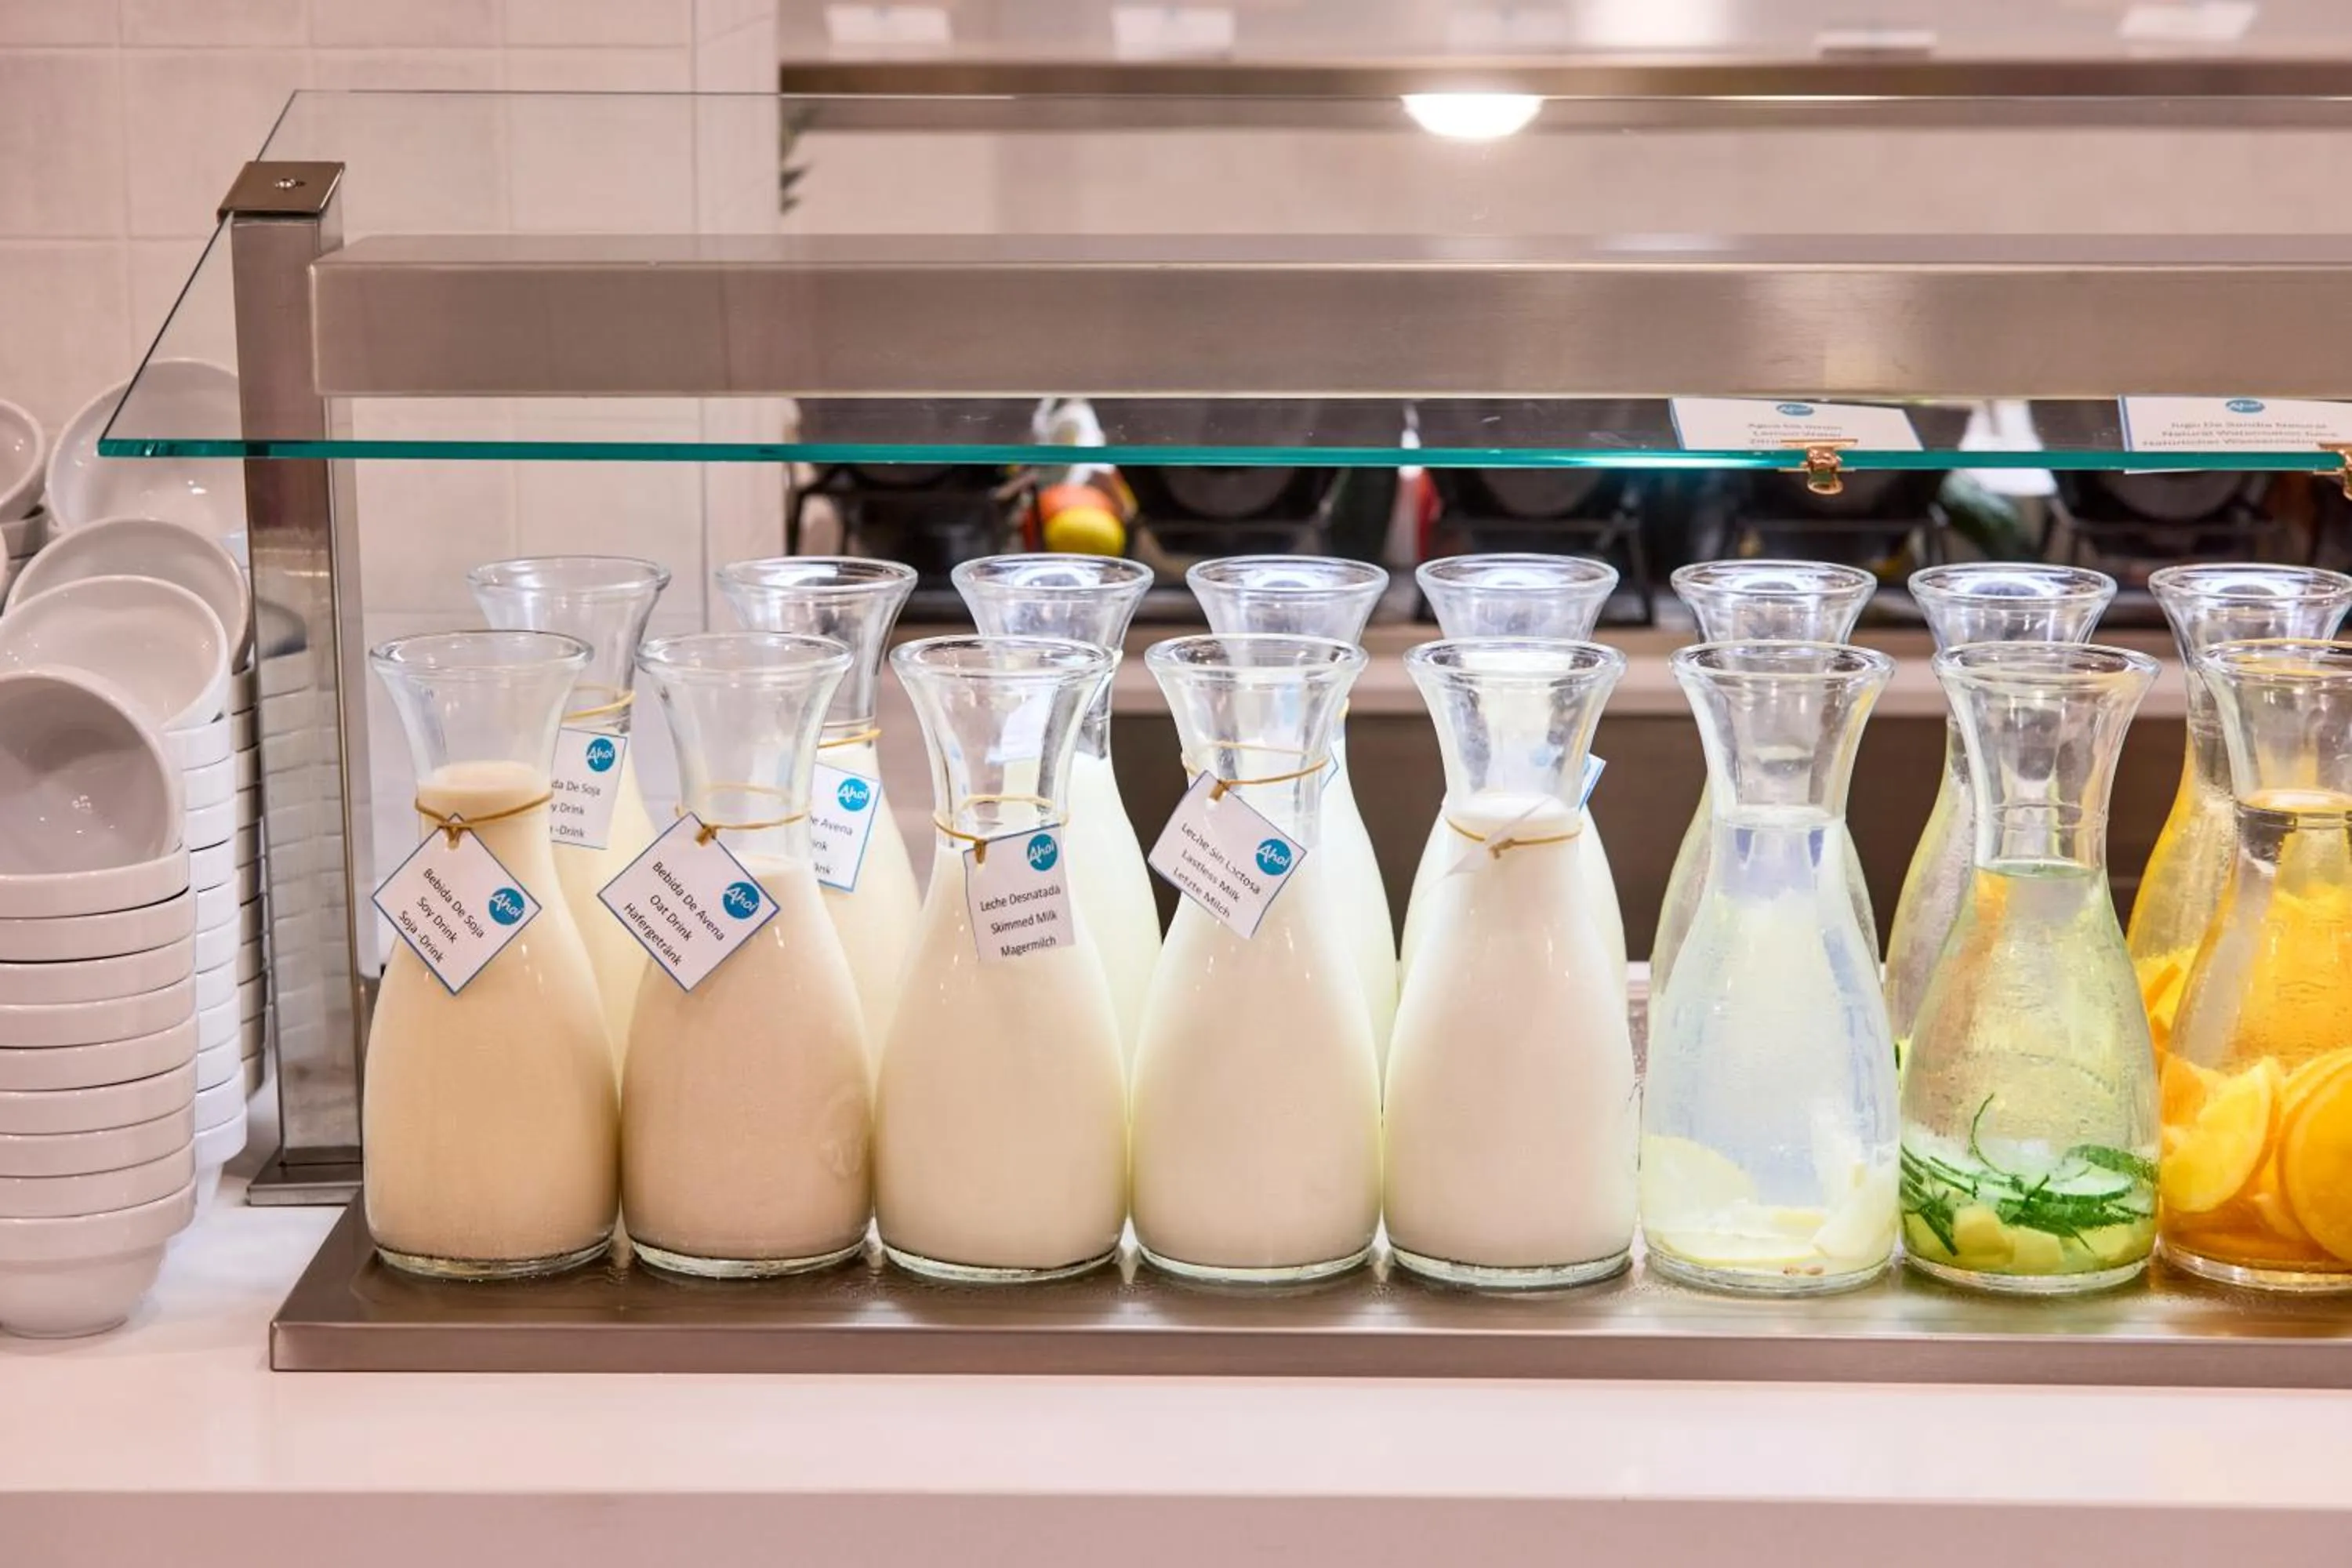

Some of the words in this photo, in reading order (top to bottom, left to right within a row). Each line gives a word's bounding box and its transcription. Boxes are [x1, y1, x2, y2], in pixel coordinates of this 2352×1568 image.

[566, 781, 579, 792] De
[559, 802, 584, 815] Drink
[1181, 822, 1210, 851] Leche
[1029, 840, 1057, 865] Ahoi
[1258, 844, 1288, 867] Ahoi
[423, 868, 452, 903] Bebida
[452, 901, 465, 917] De
[463, 915, 485, 938] Soja
[652, 861, 684, 896] Bebida
[682, 894, 697, 911] De
[695, 910, 724, 941] Avena
[726, 887, 760, 912] Ahoi
[980, 898, 1007, 912] Leche
[1009, 885, 1061, 905] Desnatada
[1219, 880, 1240, 902] Milk
[490, 893, 523, 918] Ahoi
[1203, 892, 1230, 918] Milch
[398, 910, 418, 934] Soja
[416, 896, 435, 918] Soy
[433, 915, 457, 944] Drink
[650, 895, 669, 915] Oat
[666, 913, 691, 942] Drink
[990, 914, 1034, 935] Skimmed
[1036, 910, 1057, 923] Milk
[624, 902, 681, 966] Hafergetränk
[1000, 936, 1056, 956] Magermilch
